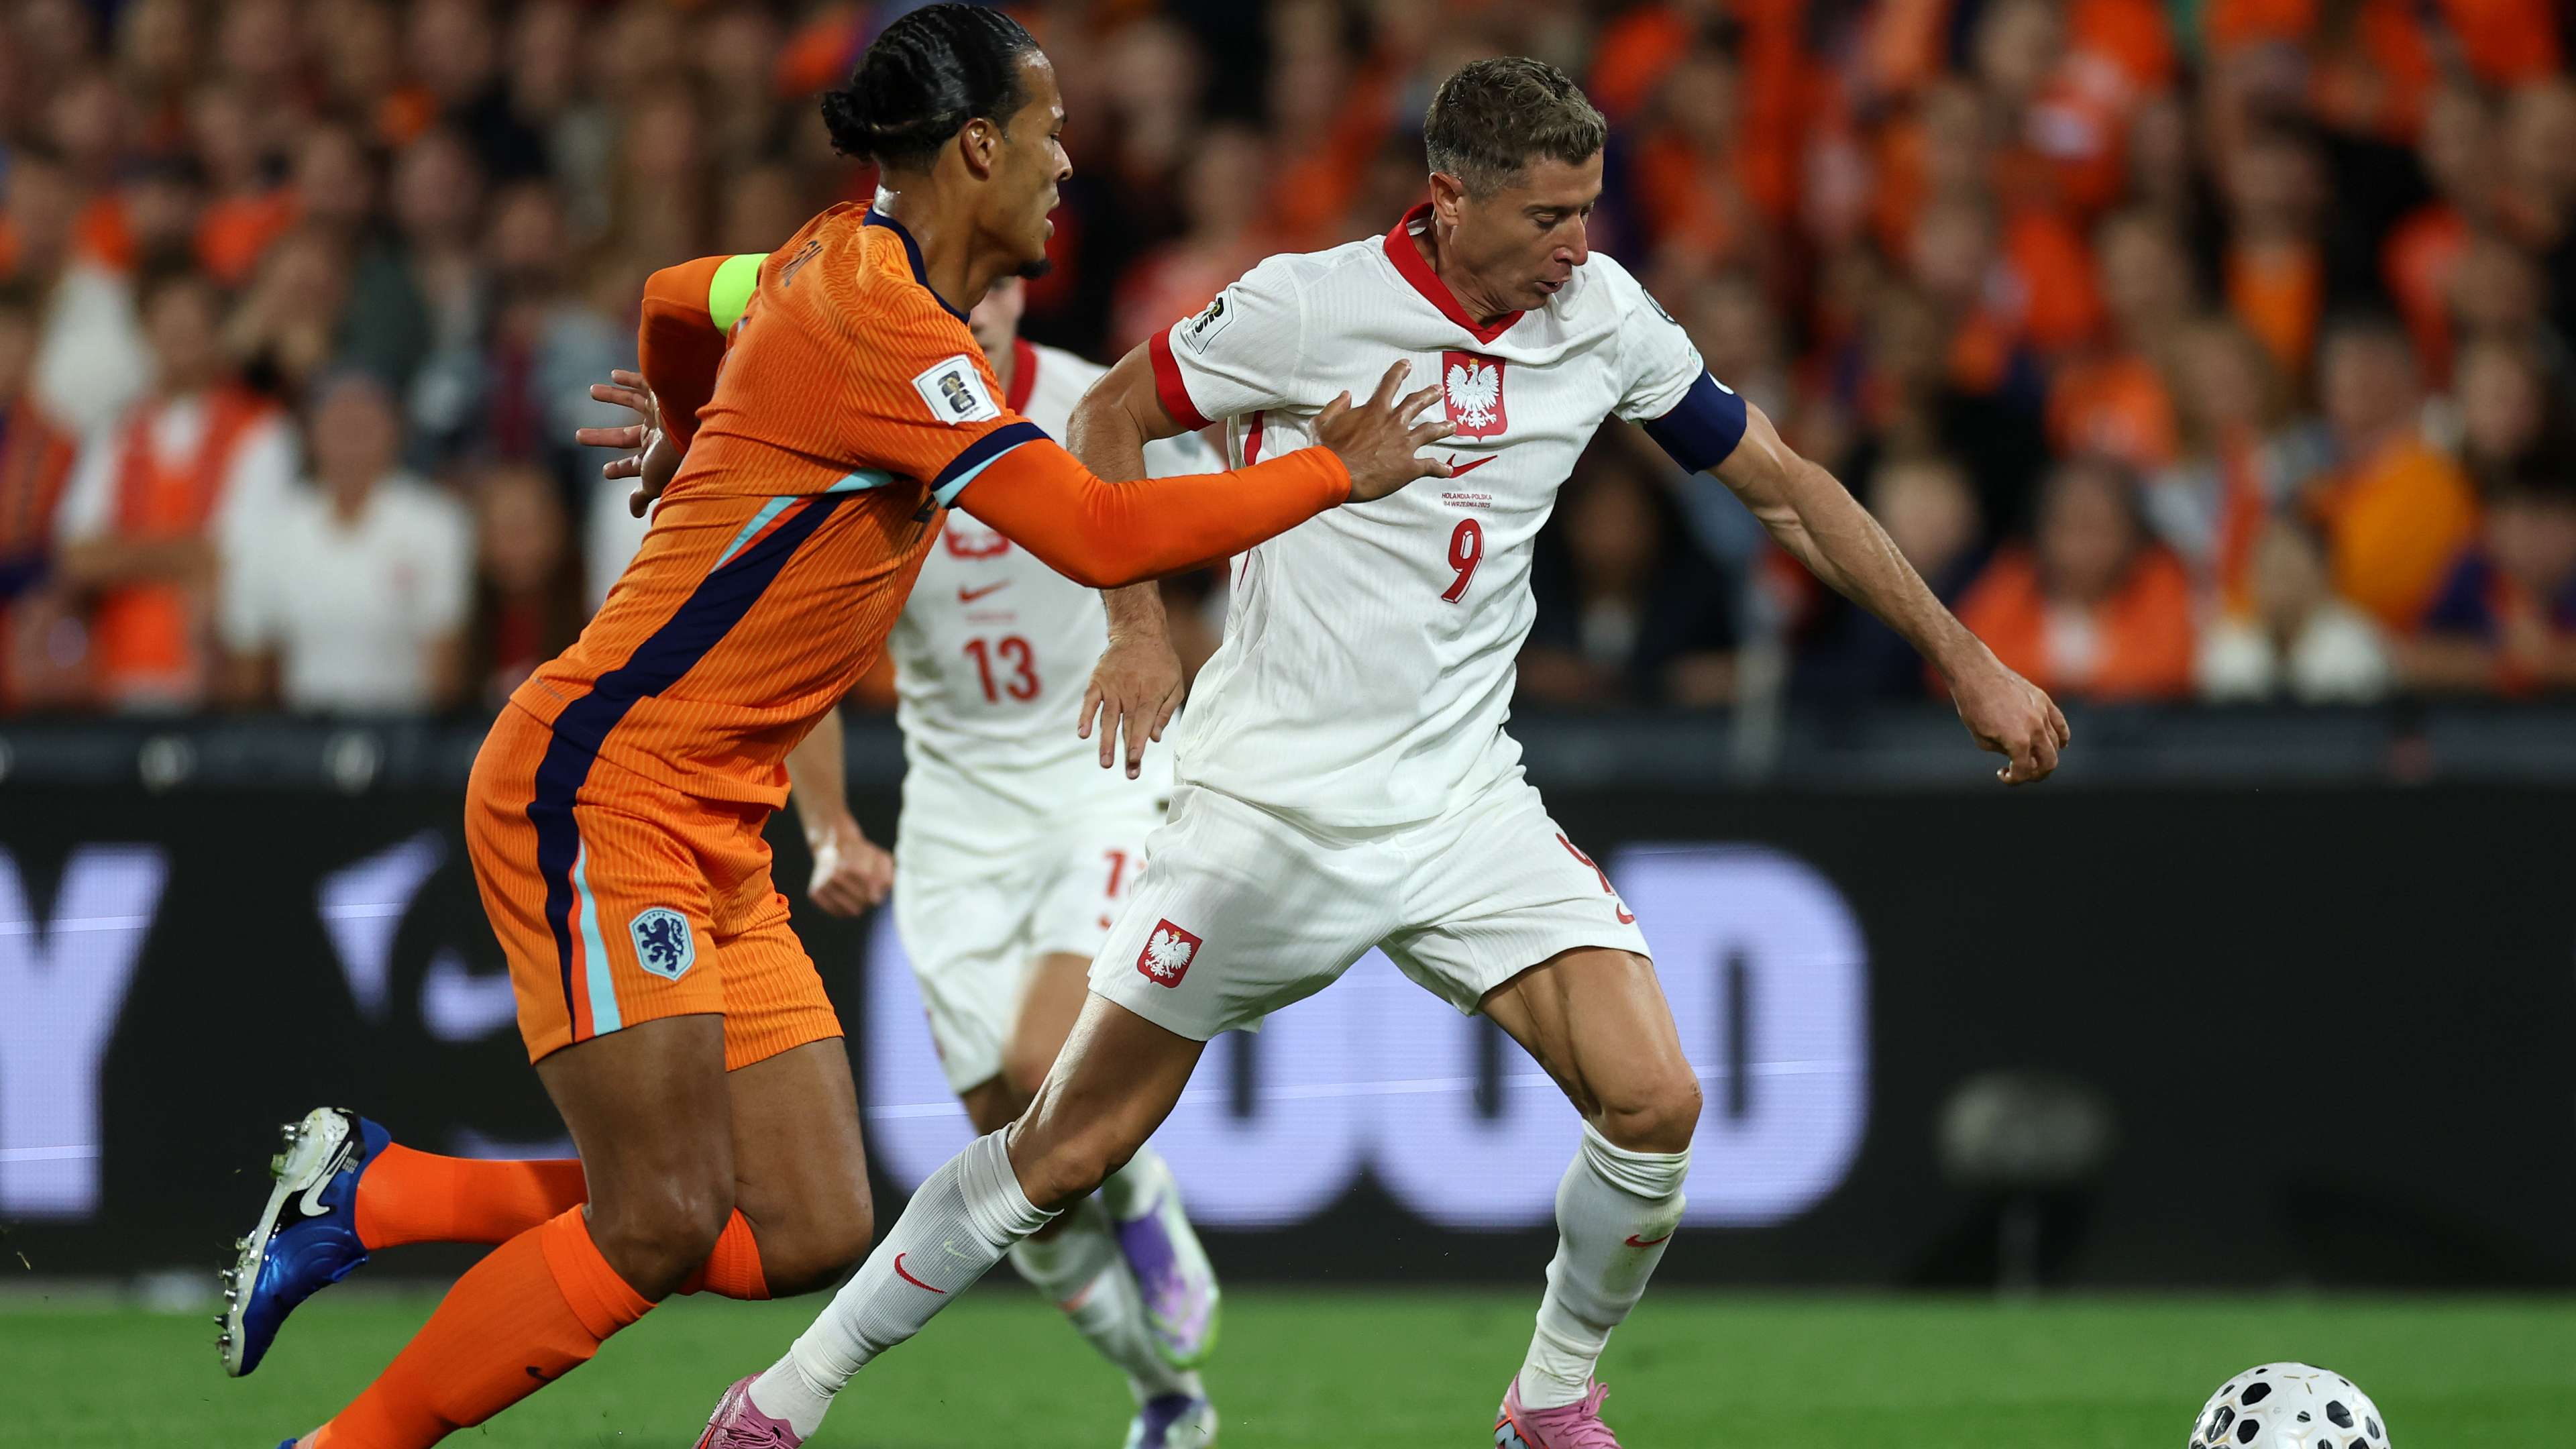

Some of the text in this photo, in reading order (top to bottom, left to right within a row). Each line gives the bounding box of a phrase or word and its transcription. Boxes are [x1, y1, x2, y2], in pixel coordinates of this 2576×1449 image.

[1442, 492, 1493, 500] HOLANDIA-POLSKA
[1440, 519, 1485, 604] 9
[963, 635, 1041, 704] 13
